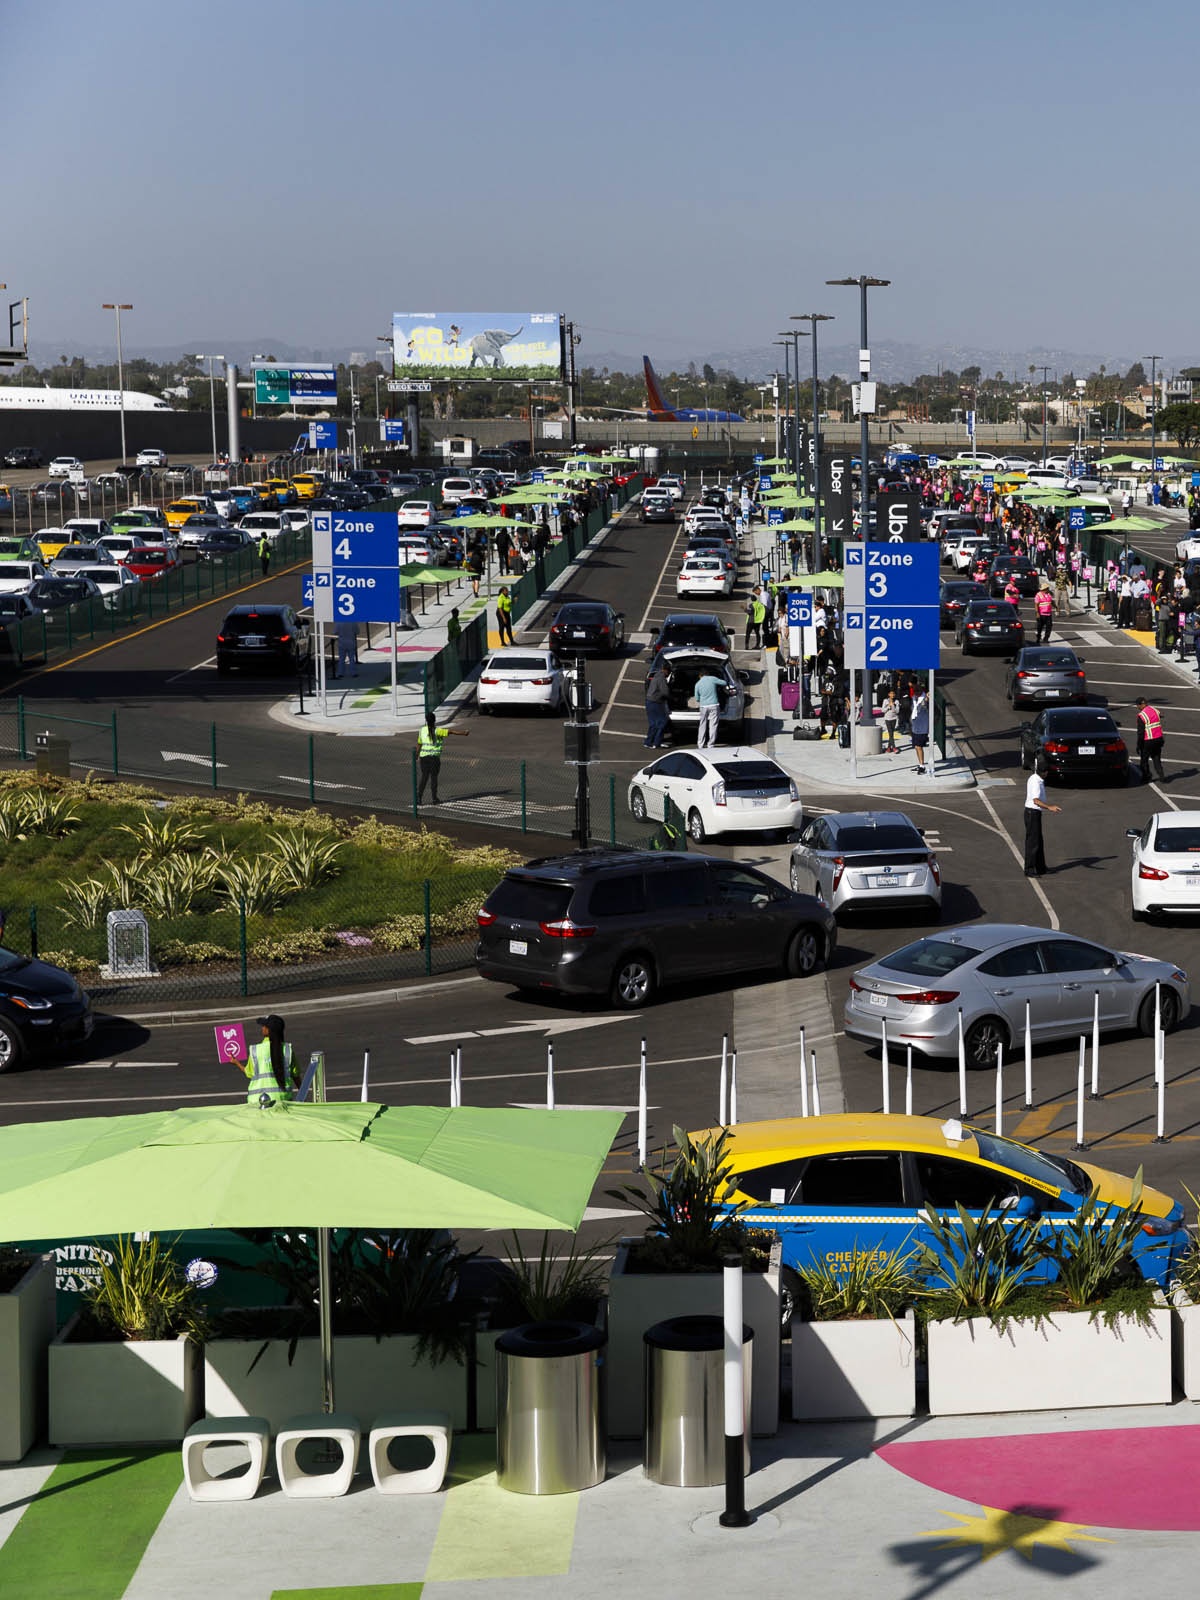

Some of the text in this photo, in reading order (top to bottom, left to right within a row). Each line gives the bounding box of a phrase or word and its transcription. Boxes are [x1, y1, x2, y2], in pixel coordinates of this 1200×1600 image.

[411, 327, 443, 345] GO
[69, 393, 122, 401] UNITED
[831, 459, 844, 494] Uber
[334, 519, 375, 533] Zone
[1071, 517, 1084, 526] 2C
[335, 538, 352, 560] 4
[868, 551, 913, 566] Zone
[335, 575, 376, 588] Zone
[869, 572, 888, 598] 3
[338, 593, 355, 616] 3
[789, 607, 811, 620] 3D
[869, 615, 914, 630] Zone
[869, 636, 888, 661] 2
[222, 1028, 237, 1040] lyft
